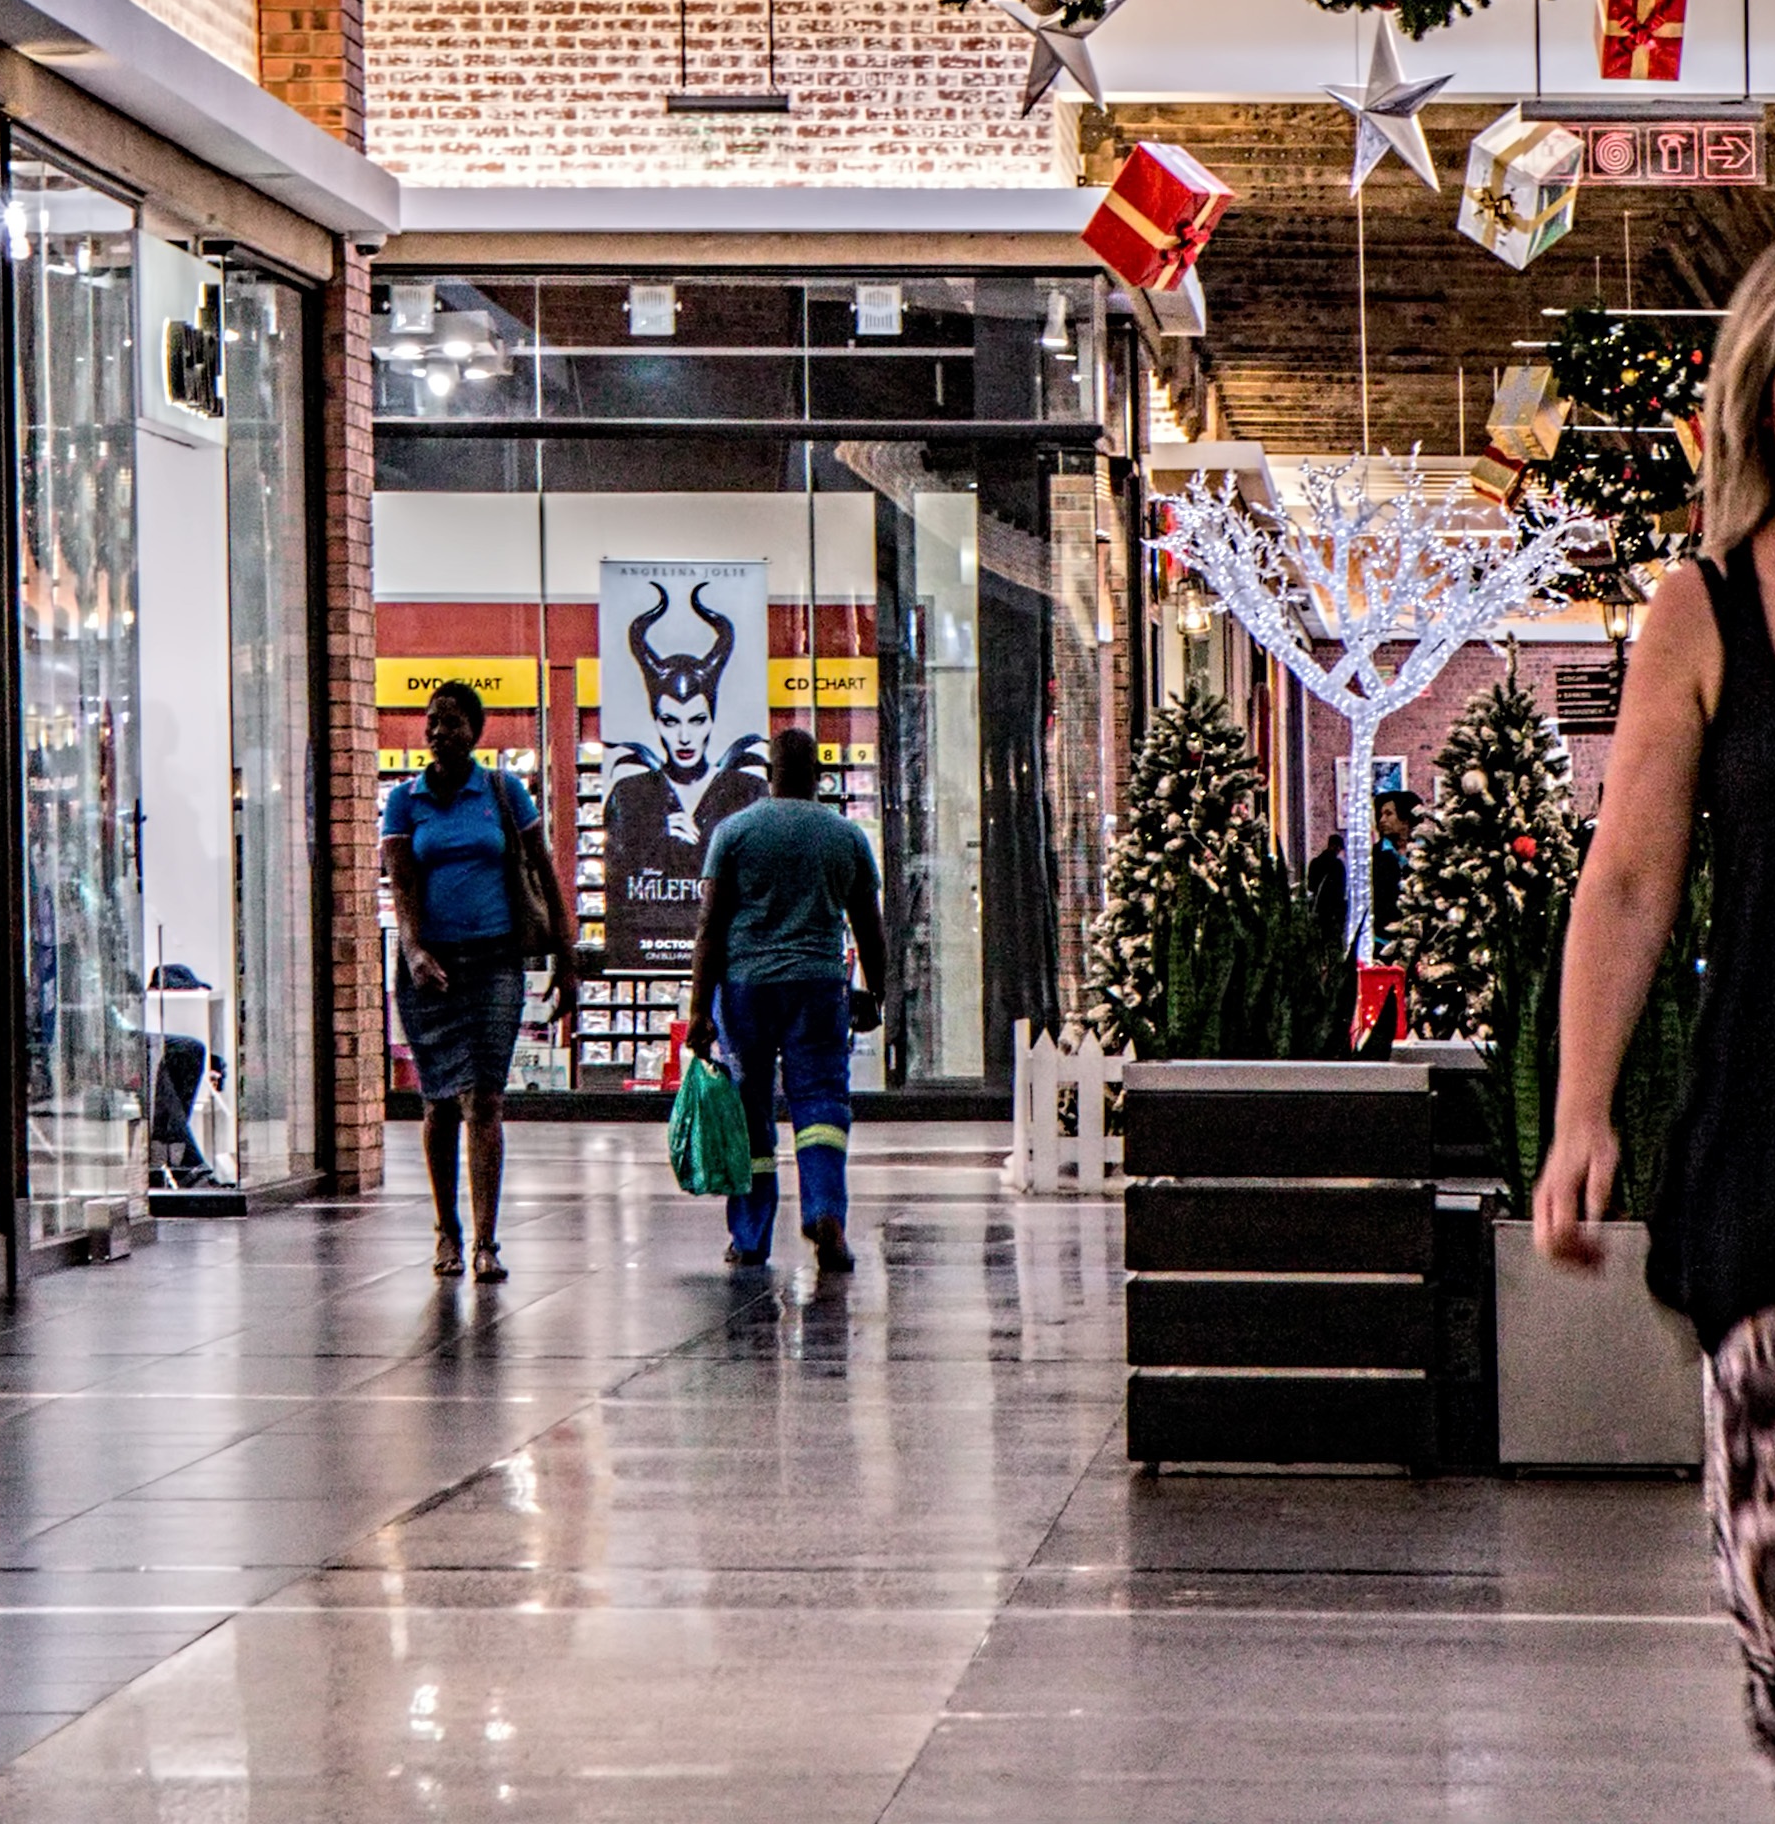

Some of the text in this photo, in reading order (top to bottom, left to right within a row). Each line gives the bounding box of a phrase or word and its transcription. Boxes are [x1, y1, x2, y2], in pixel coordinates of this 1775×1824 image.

[619, 567, 747, 579] ANGELINA JOLIE
[784, 677, 867, 691] CD CHART
[823, 749, 833, 761] 8
[857, 750, 867, 761] 9
[416, 755, 426, 768] 2
